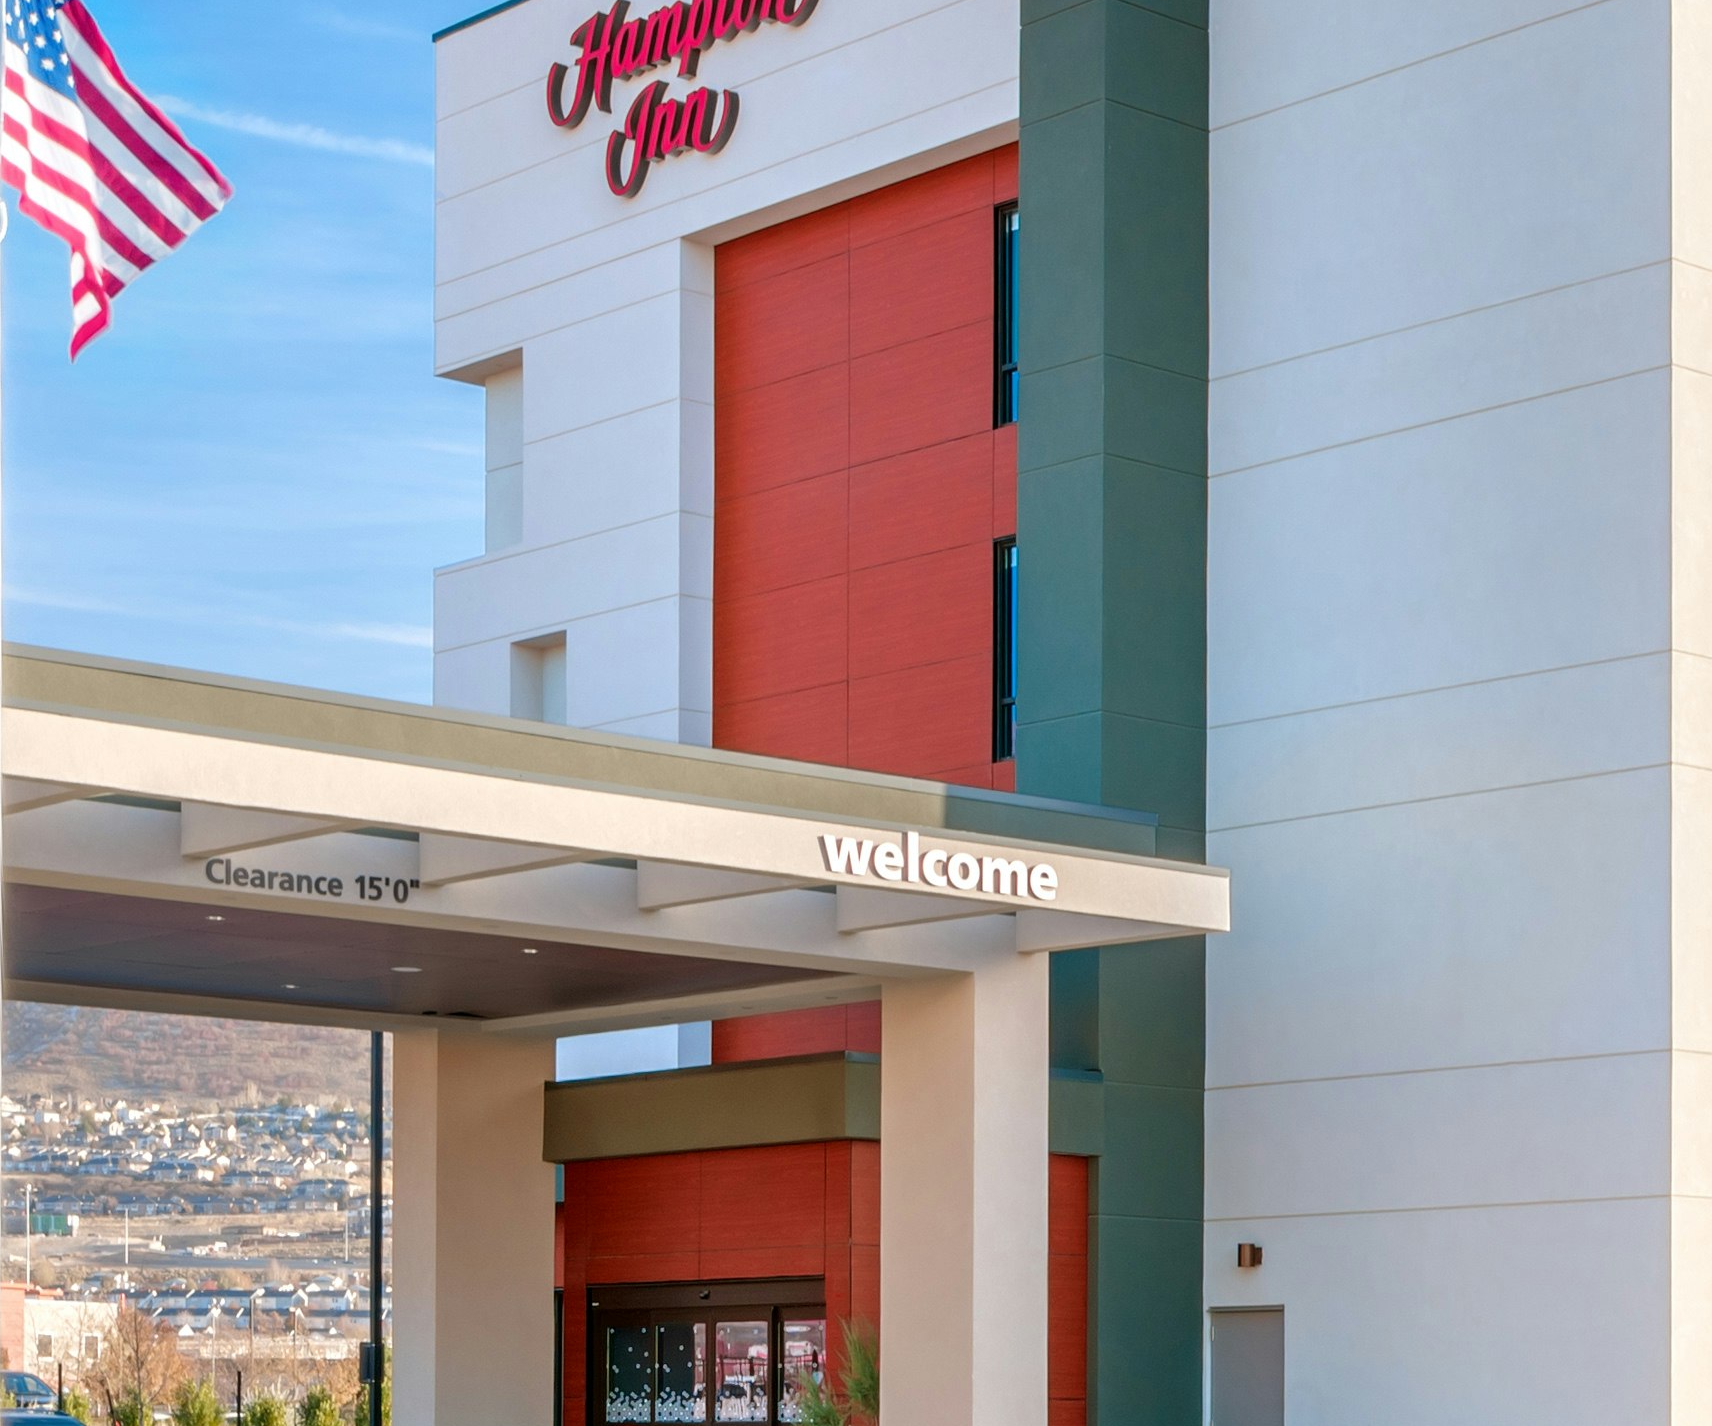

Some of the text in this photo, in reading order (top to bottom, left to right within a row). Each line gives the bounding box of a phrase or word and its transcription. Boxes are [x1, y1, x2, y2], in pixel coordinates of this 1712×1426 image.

[606, 80, 740, 199] Inn
[205, 858, 344, 897] Clearance
[818, 830, 1059, 901] welcome
